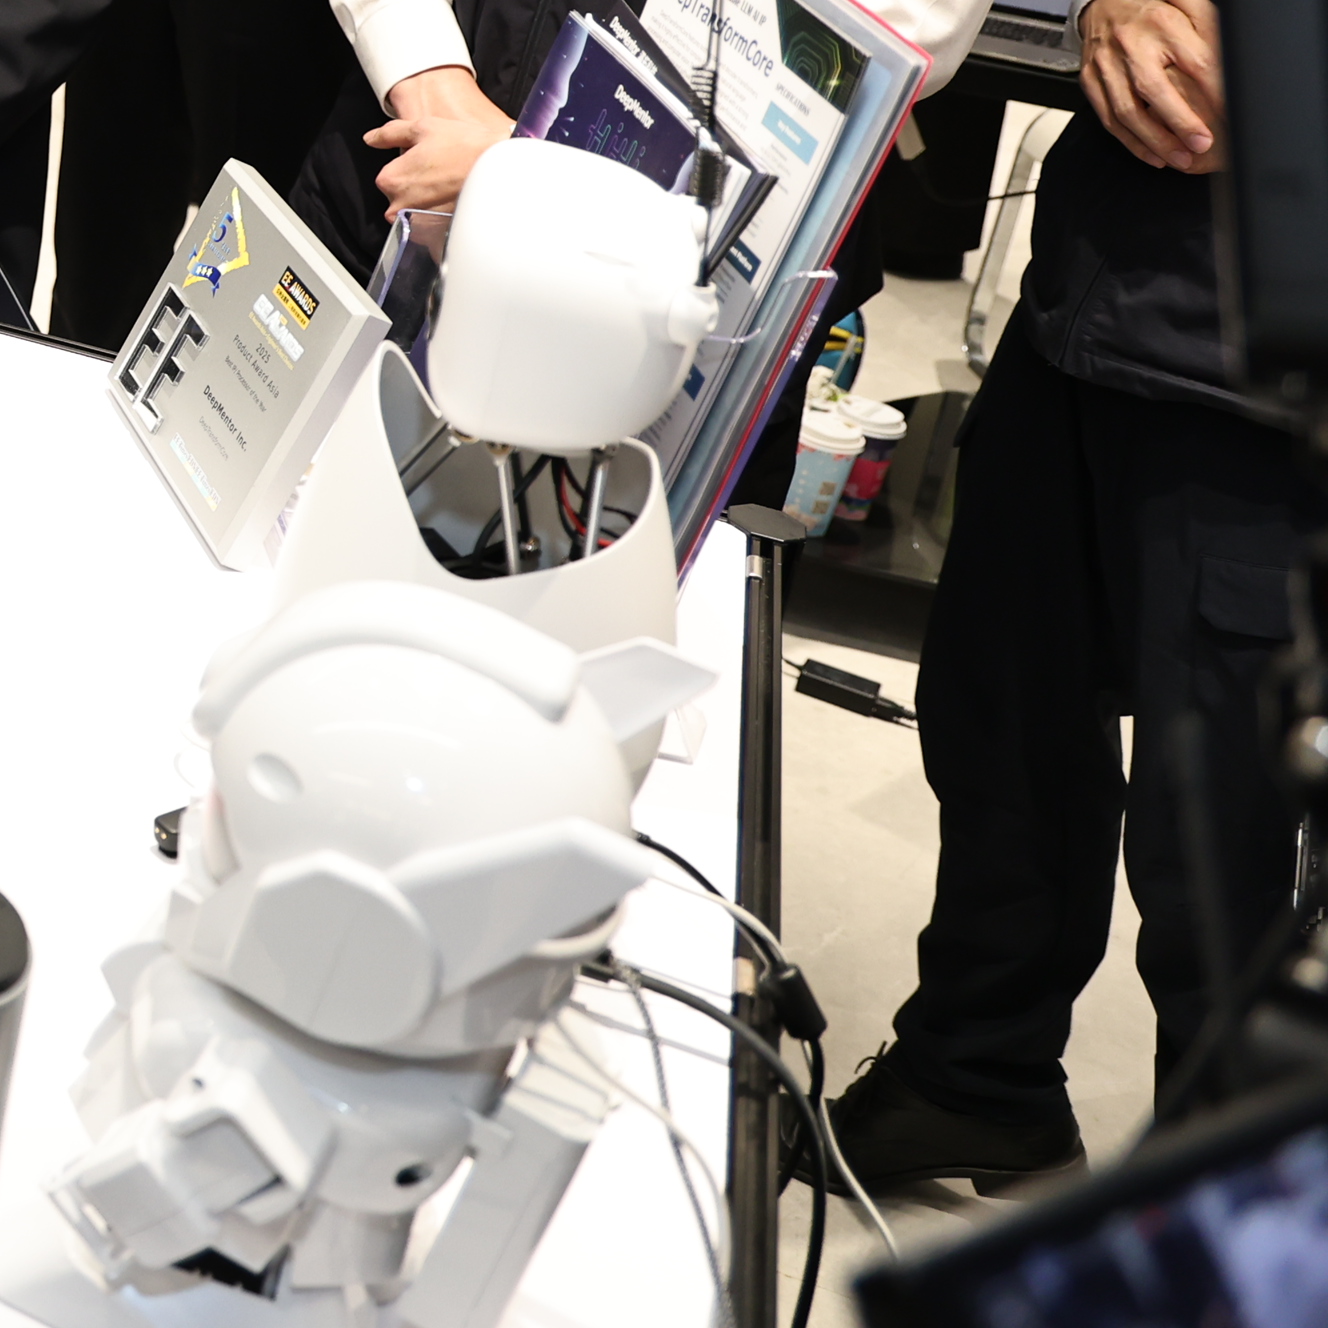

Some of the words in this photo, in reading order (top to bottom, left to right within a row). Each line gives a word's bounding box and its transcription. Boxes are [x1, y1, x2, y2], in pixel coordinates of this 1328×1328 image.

[614, 84, 655, 130] DeepMentor
[212, 211, 234, 243] 5
[287, 280, 317, 316] AWARDS
[232, 334, 253, 364] Product
[251, 358, 269, 383] Award
[266, 380, 280, 399] Asia
[255, 343, 271, 364] 2025
[203, 384, 238, 436] DeepMentor
[236, 430, 248, 453] Inc.
